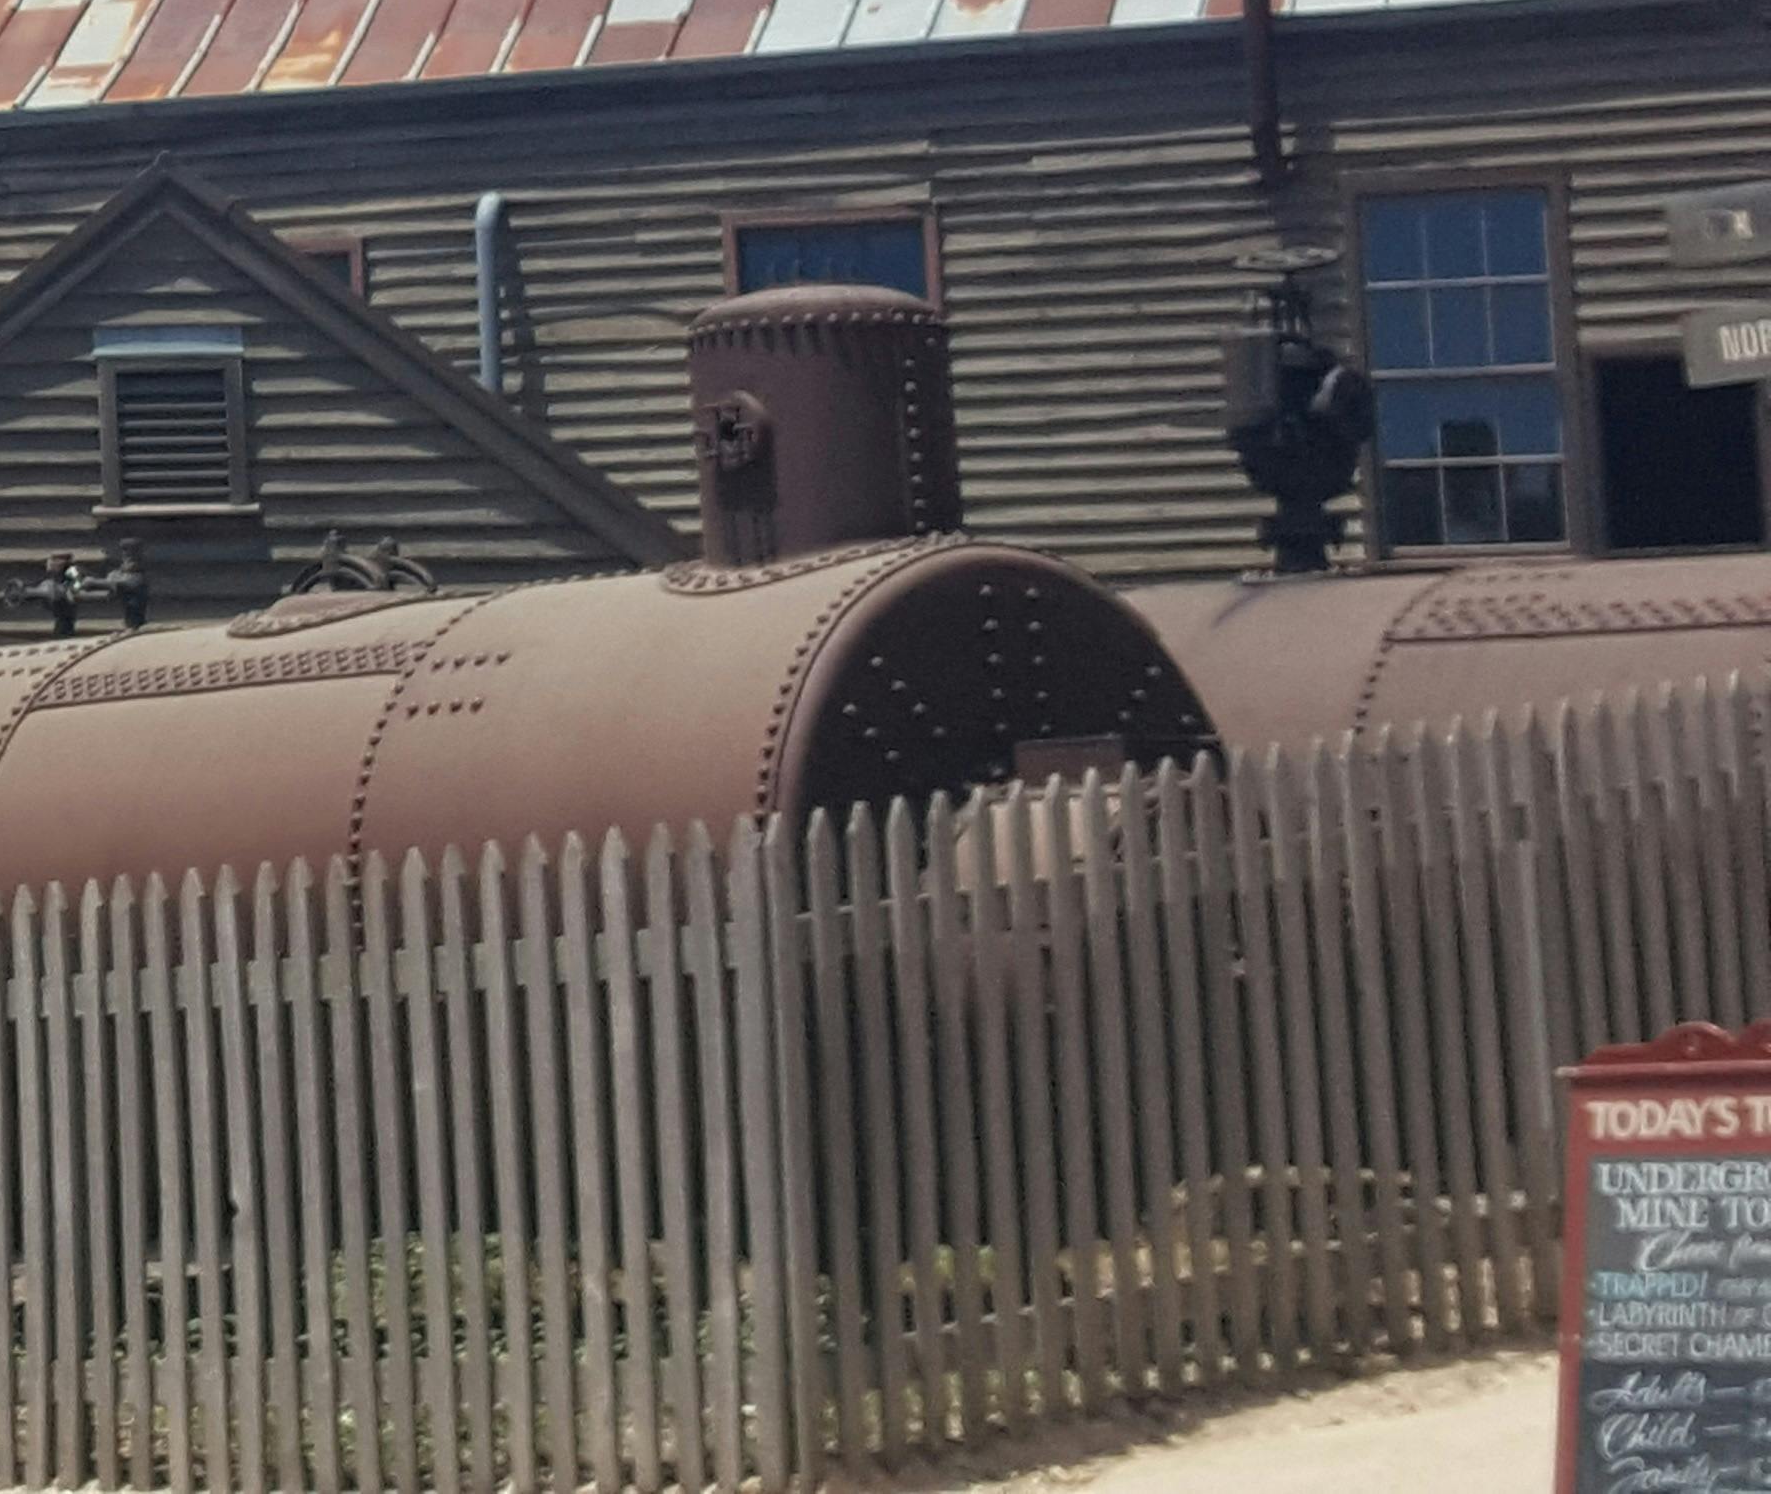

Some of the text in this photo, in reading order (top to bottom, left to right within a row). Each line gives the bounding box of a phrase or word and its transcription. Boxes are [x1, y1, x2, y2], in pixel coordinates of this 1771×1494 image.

[1743, 1094, 1771, 1138] T
[1616, 1194, 1710, 1230] MINE
[1597, 1300, 1729, 1328] LABYRINTH
[1596, 1331, 1680, 1358] SECRET
